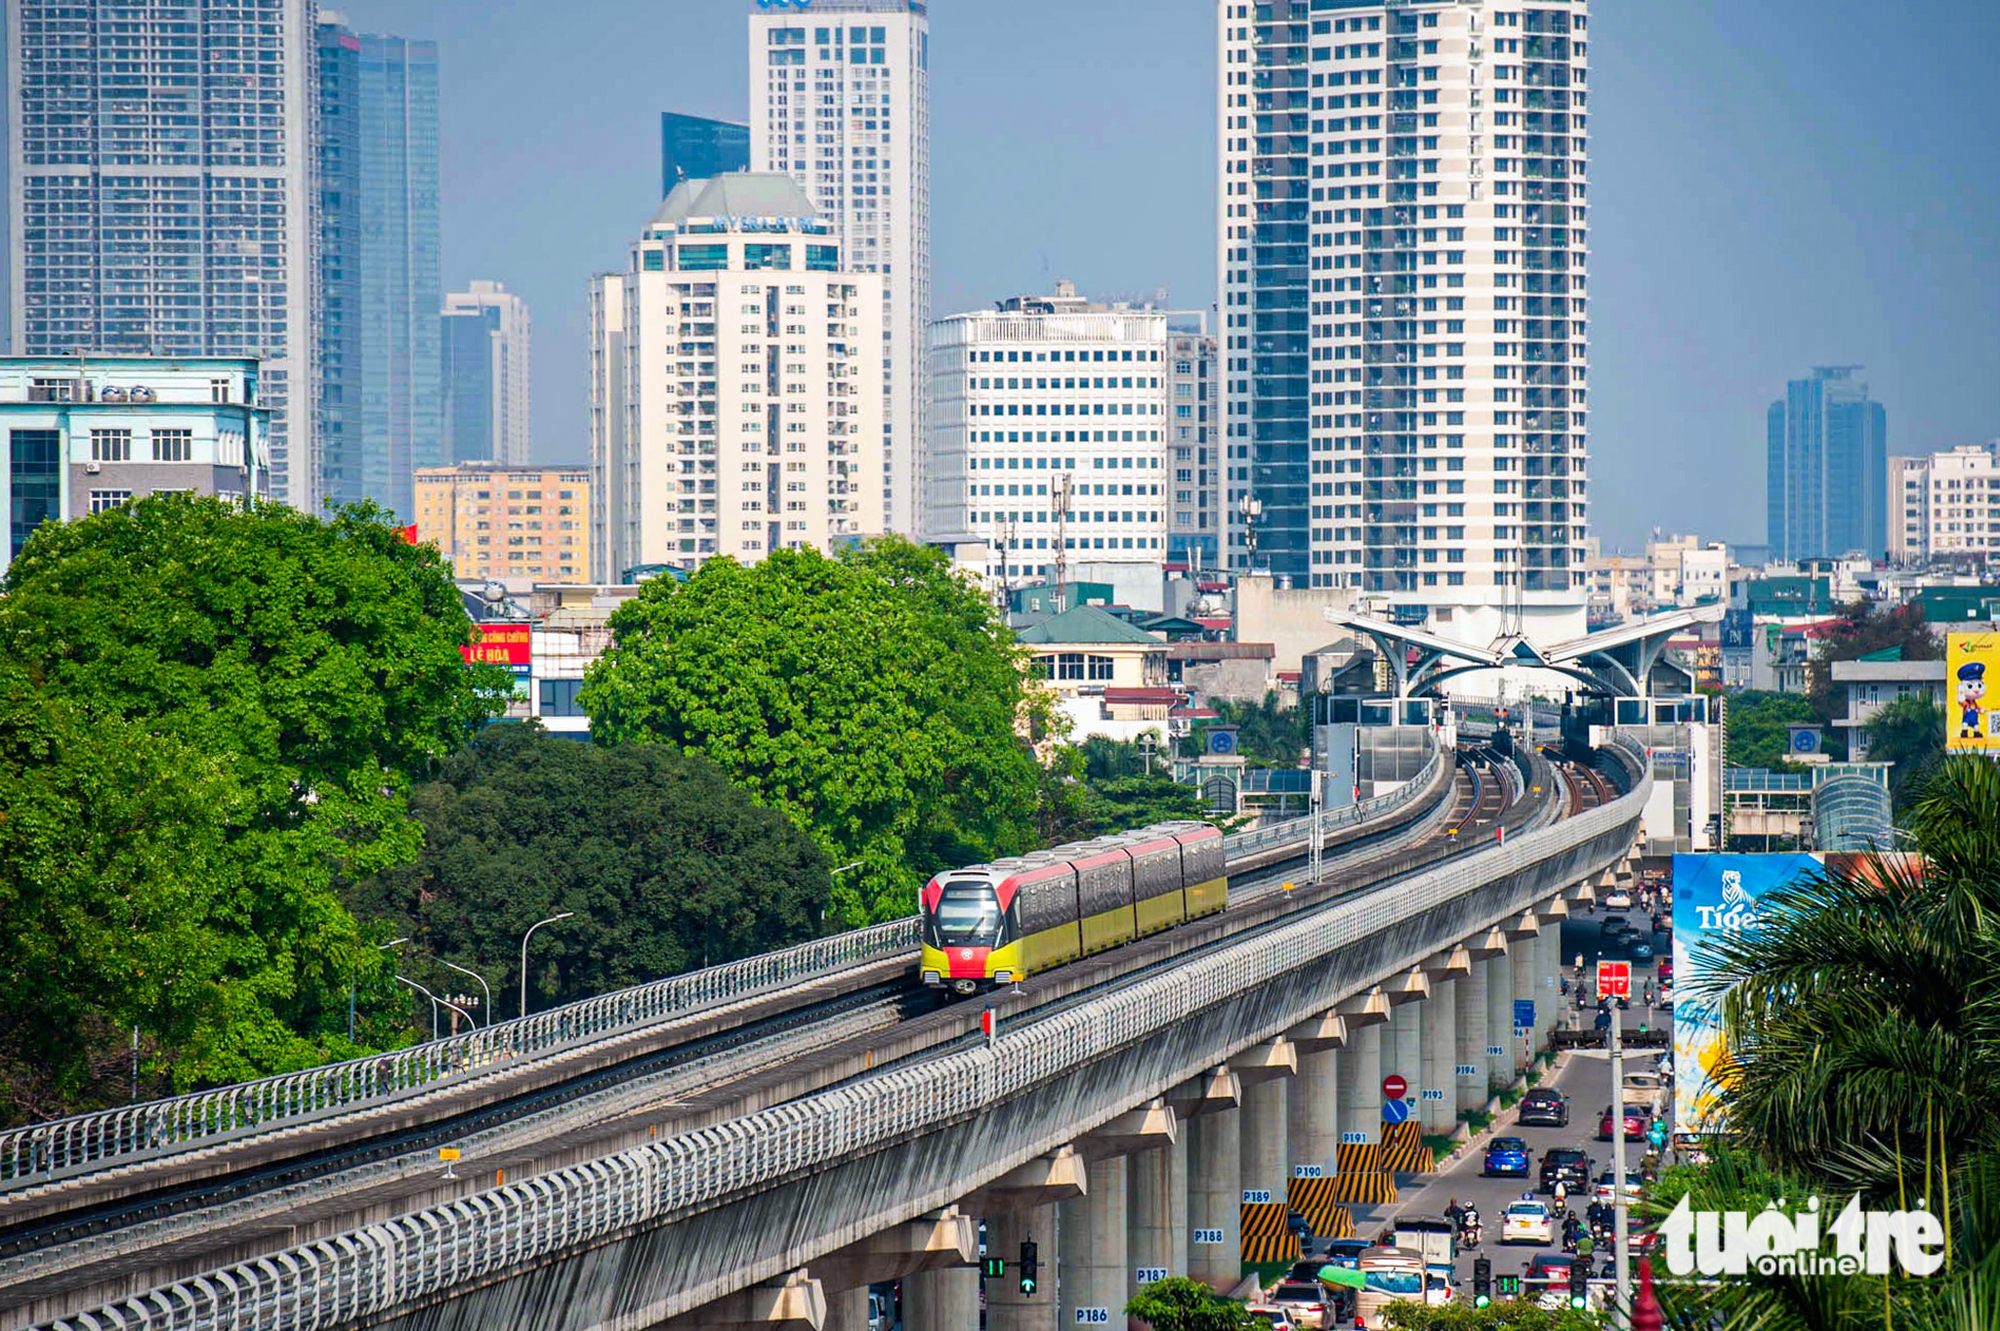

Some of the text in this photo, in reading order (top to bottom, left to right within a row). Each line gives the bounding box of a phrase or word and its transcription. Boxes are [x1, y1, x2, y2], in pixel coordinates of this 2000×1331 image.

[1343, 1133, 1367, 1143] P191
[1296, 1166, 1321, 1177] P190
[1243, 1191, 1270, 1202] P189
[1194, 1230, 1222, 1242] P188
[988, 1259, 1004, 1276] 11
[1137, 1269, 1167, 1282] P187
[1502, 1277, 1518, 1293] 11
[1076, 1309, 1108, 1322] P186
